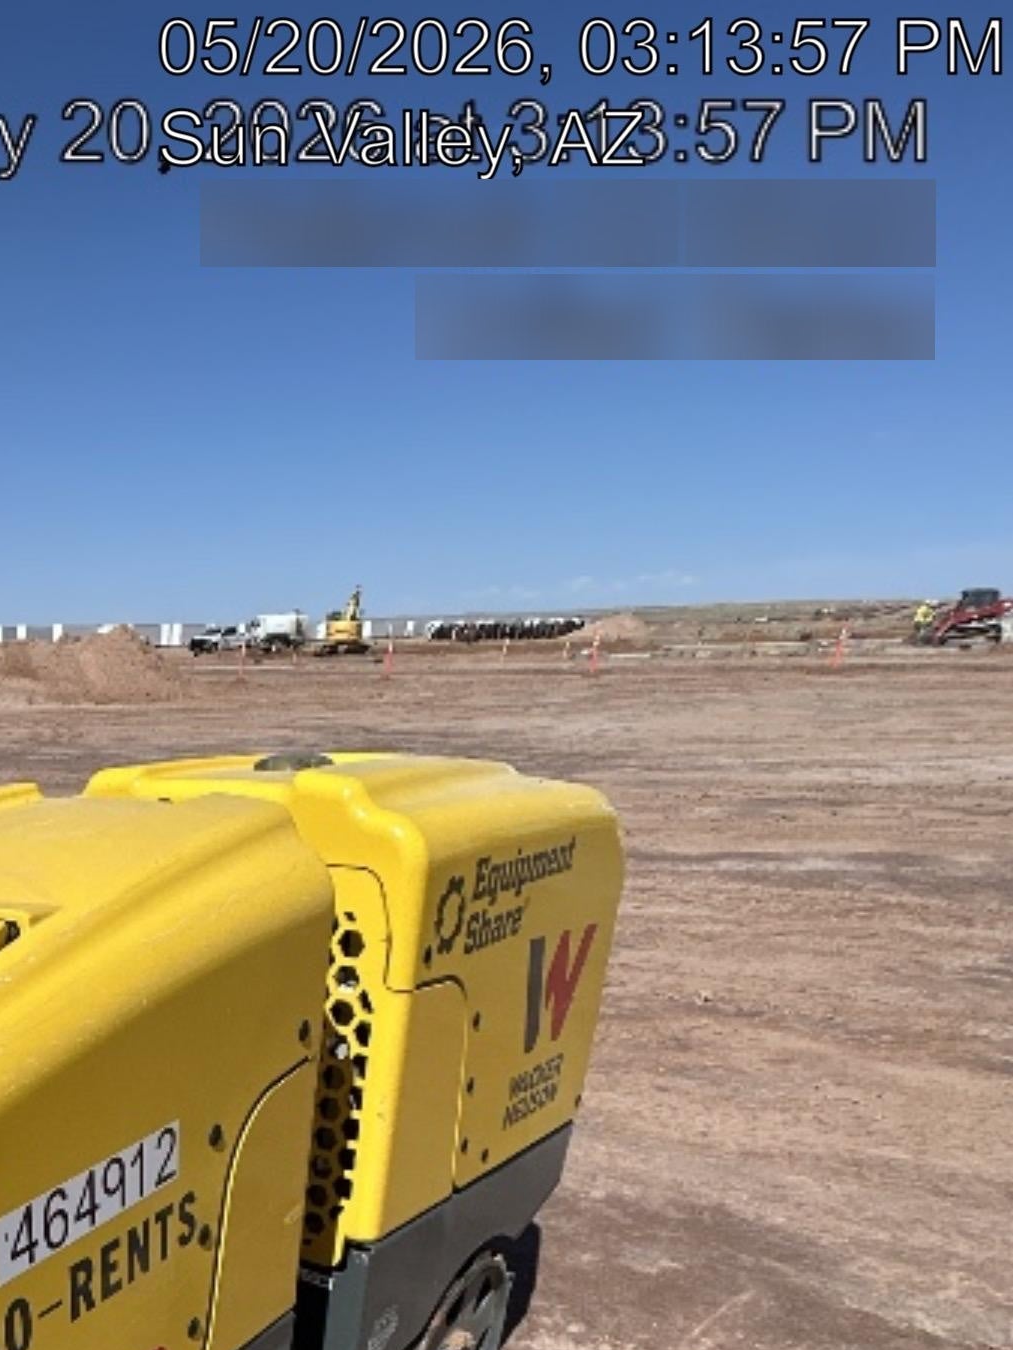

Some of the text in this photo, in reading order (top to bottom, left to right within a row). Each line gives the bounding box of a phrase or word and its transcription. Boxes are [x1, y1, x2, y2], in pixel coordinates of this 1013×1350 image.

[471, 836, 576, 905] Equipment
[463, 903, 524, 955] Share
[8, 1126, 178, 1266] 464912
